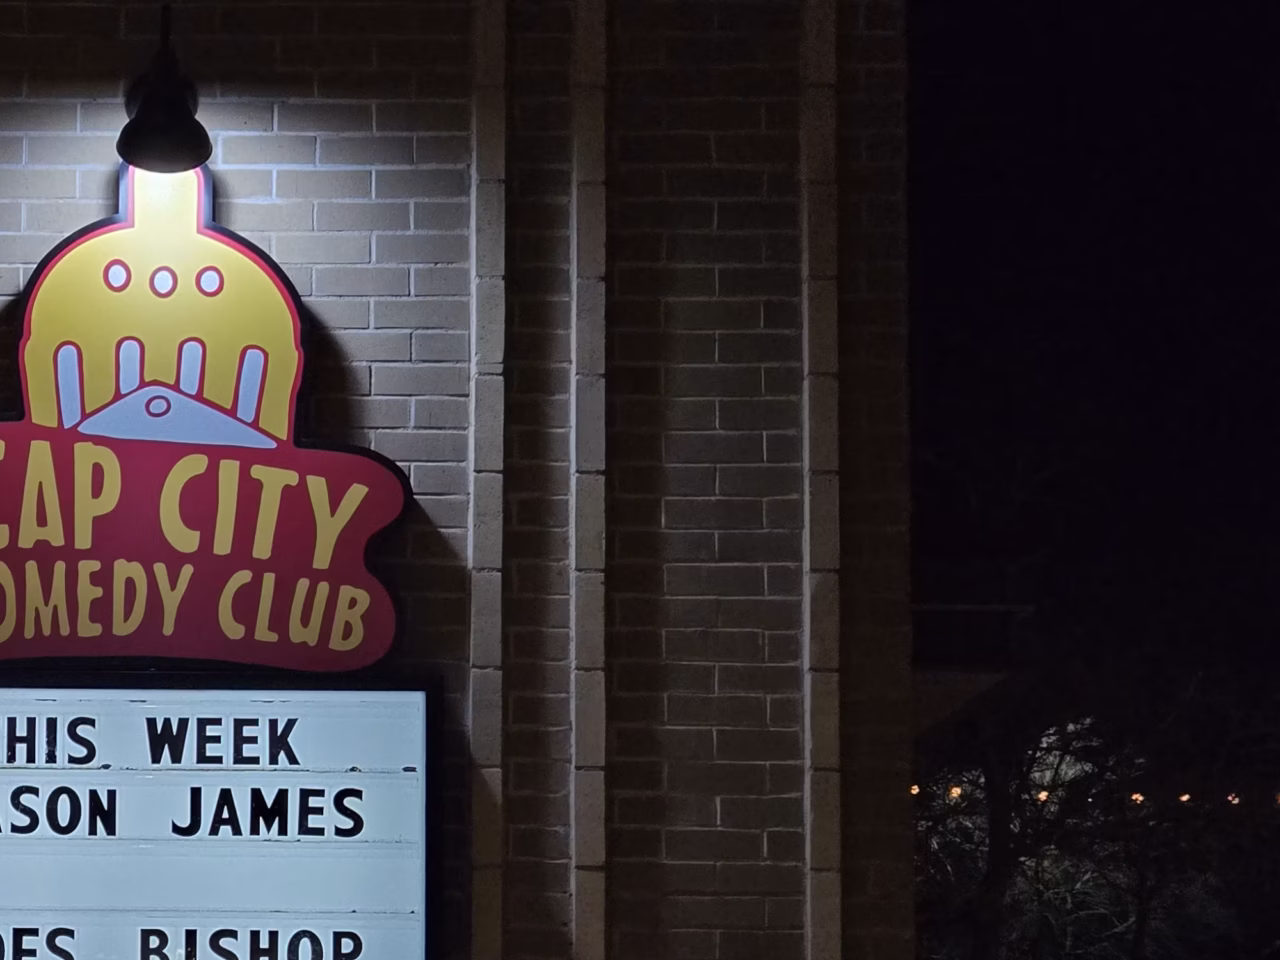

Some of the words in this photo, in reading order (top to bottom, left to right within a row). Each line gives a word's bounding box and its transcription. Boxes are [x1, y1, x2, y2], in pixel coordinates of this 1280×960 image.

[160, 454, 369, 569] CITY
[219, 570, 371, 651] CLUB
[146, 717, 300, 766] WEEK
[171, 787, 365, 838] JAMES
